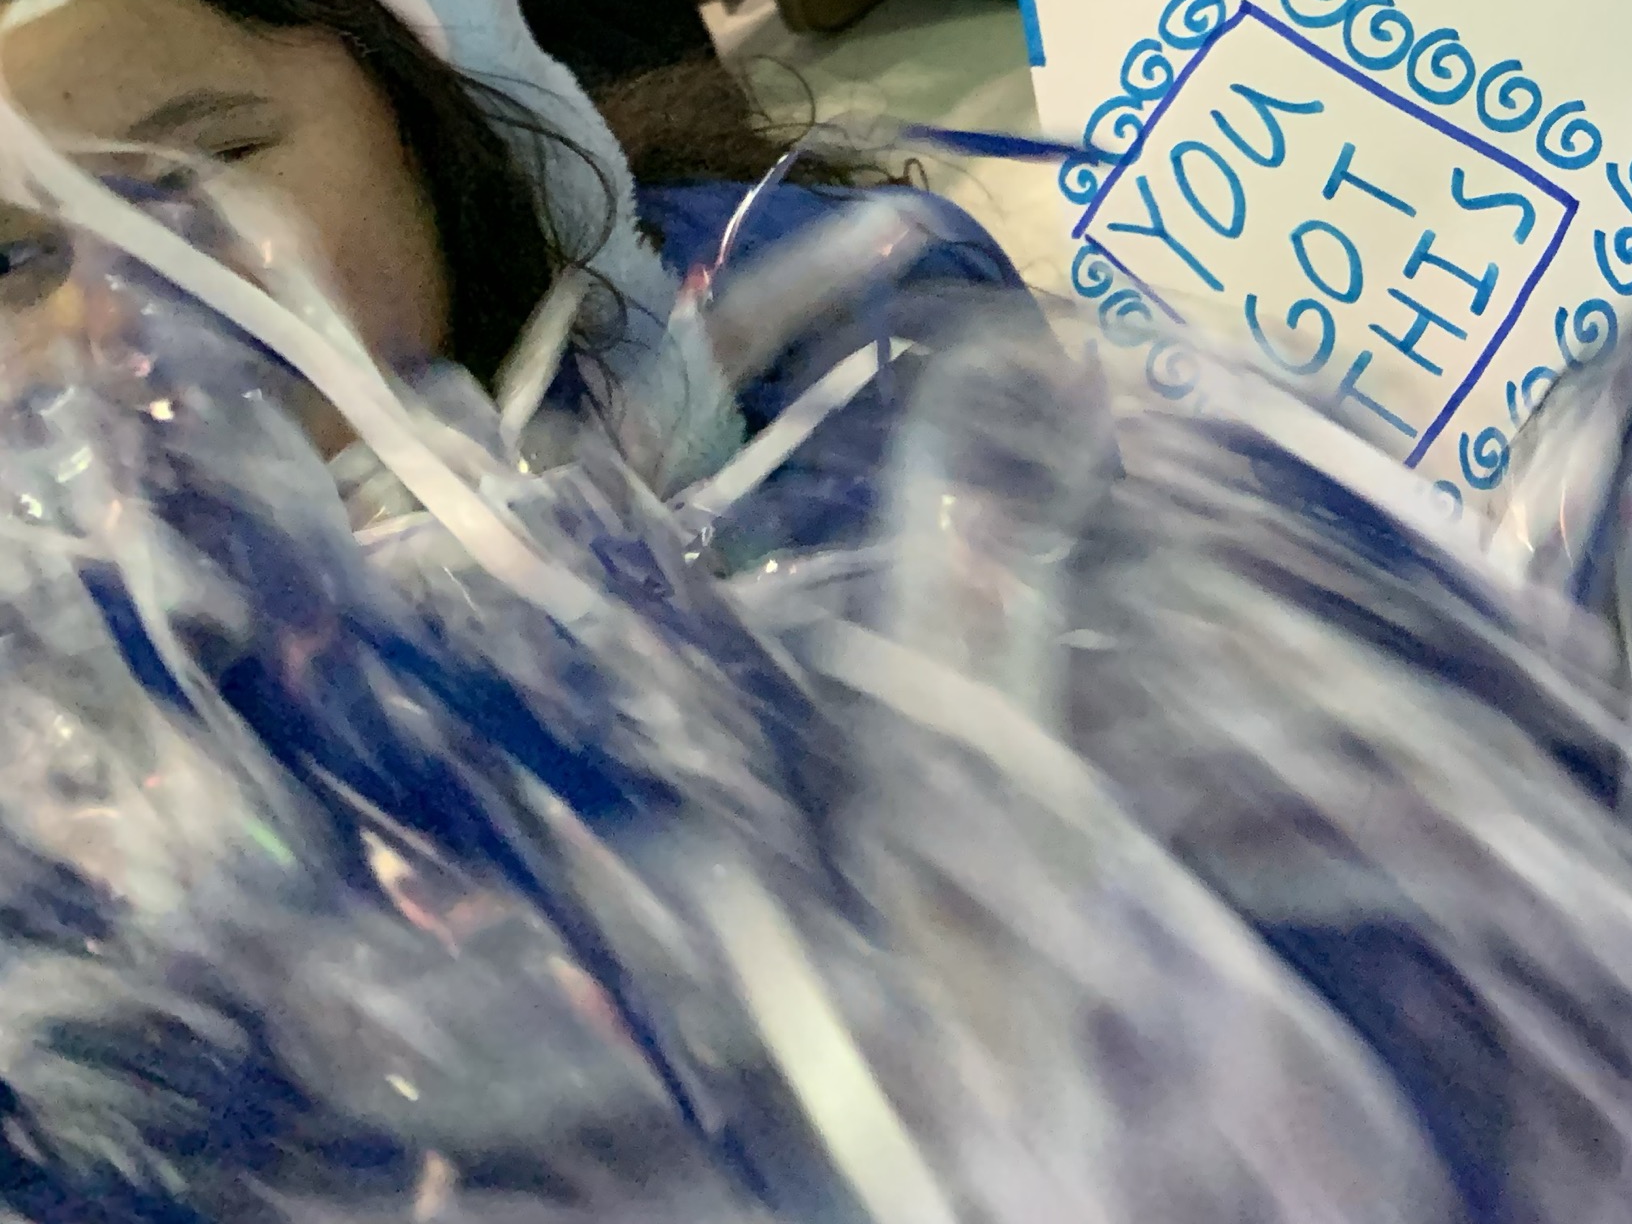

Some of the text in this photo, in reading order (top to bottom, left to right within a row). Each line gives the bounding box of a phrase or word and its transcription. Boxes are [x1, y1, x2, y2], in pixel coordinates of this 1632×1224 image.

[1107, 83, 1324, 292] YOU
[1244, 142, 1417, 376] GOT
[1333, 167, 1537, 439] THIS
